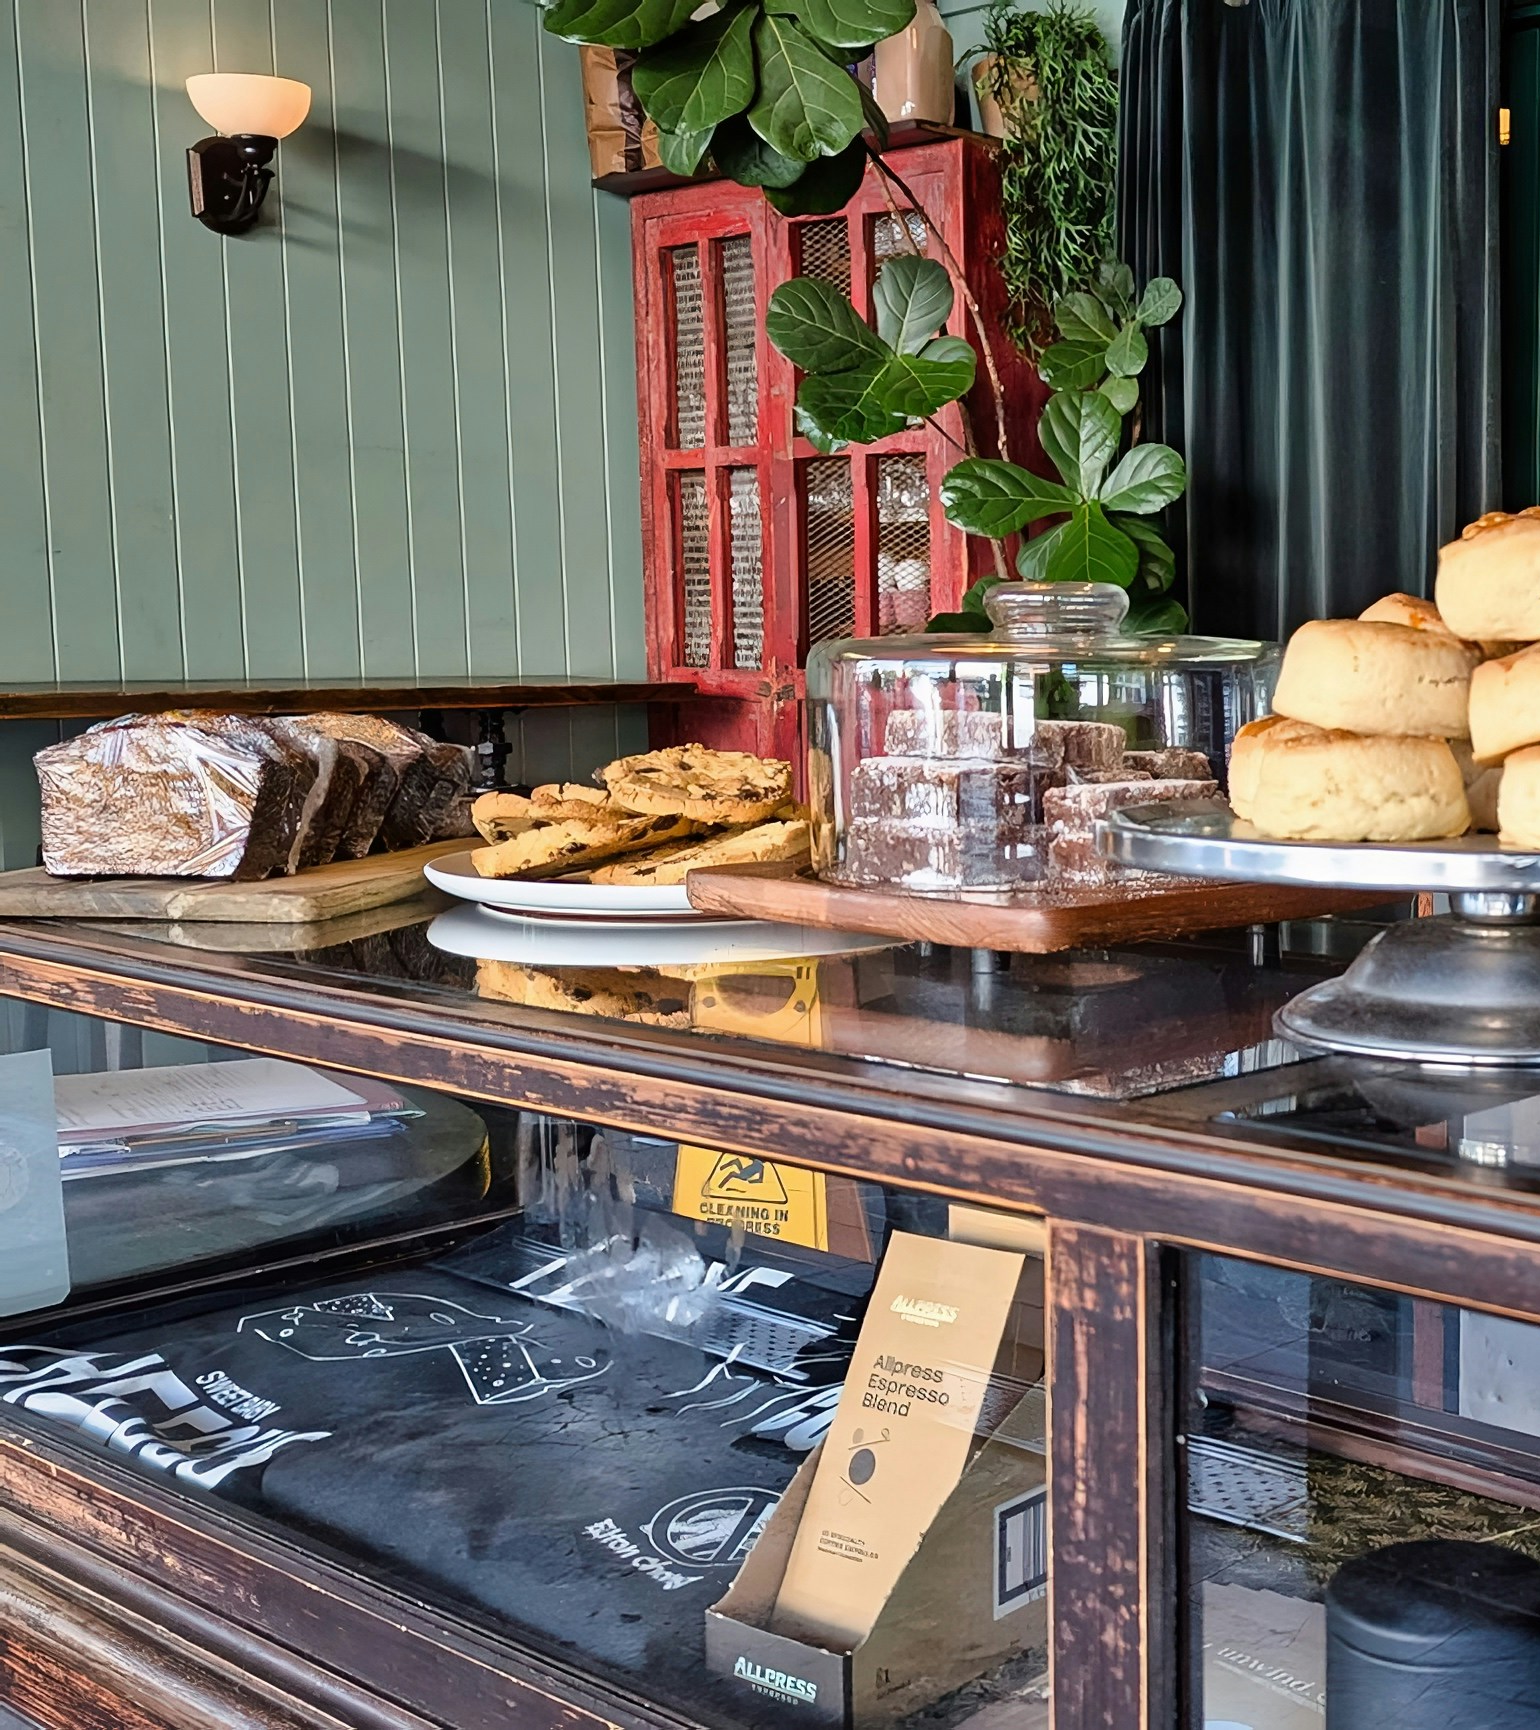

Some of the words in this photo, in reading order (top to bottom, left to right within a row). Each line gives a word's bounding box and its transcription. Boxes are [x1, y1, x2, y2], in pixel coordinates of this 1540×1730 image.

[699, 1202, 770, 1221] CLEANING
[774, 1209, 789, 1222] IN
[706, 1217, 781, 1236] RESS
[873, 1354, 944, 1384] Allpress
[868, 1373, 950, 1406] Espresso
[862, 1392, 912, 1417] Blend
[734, 1656, 818, 1700] ALLPRESS
